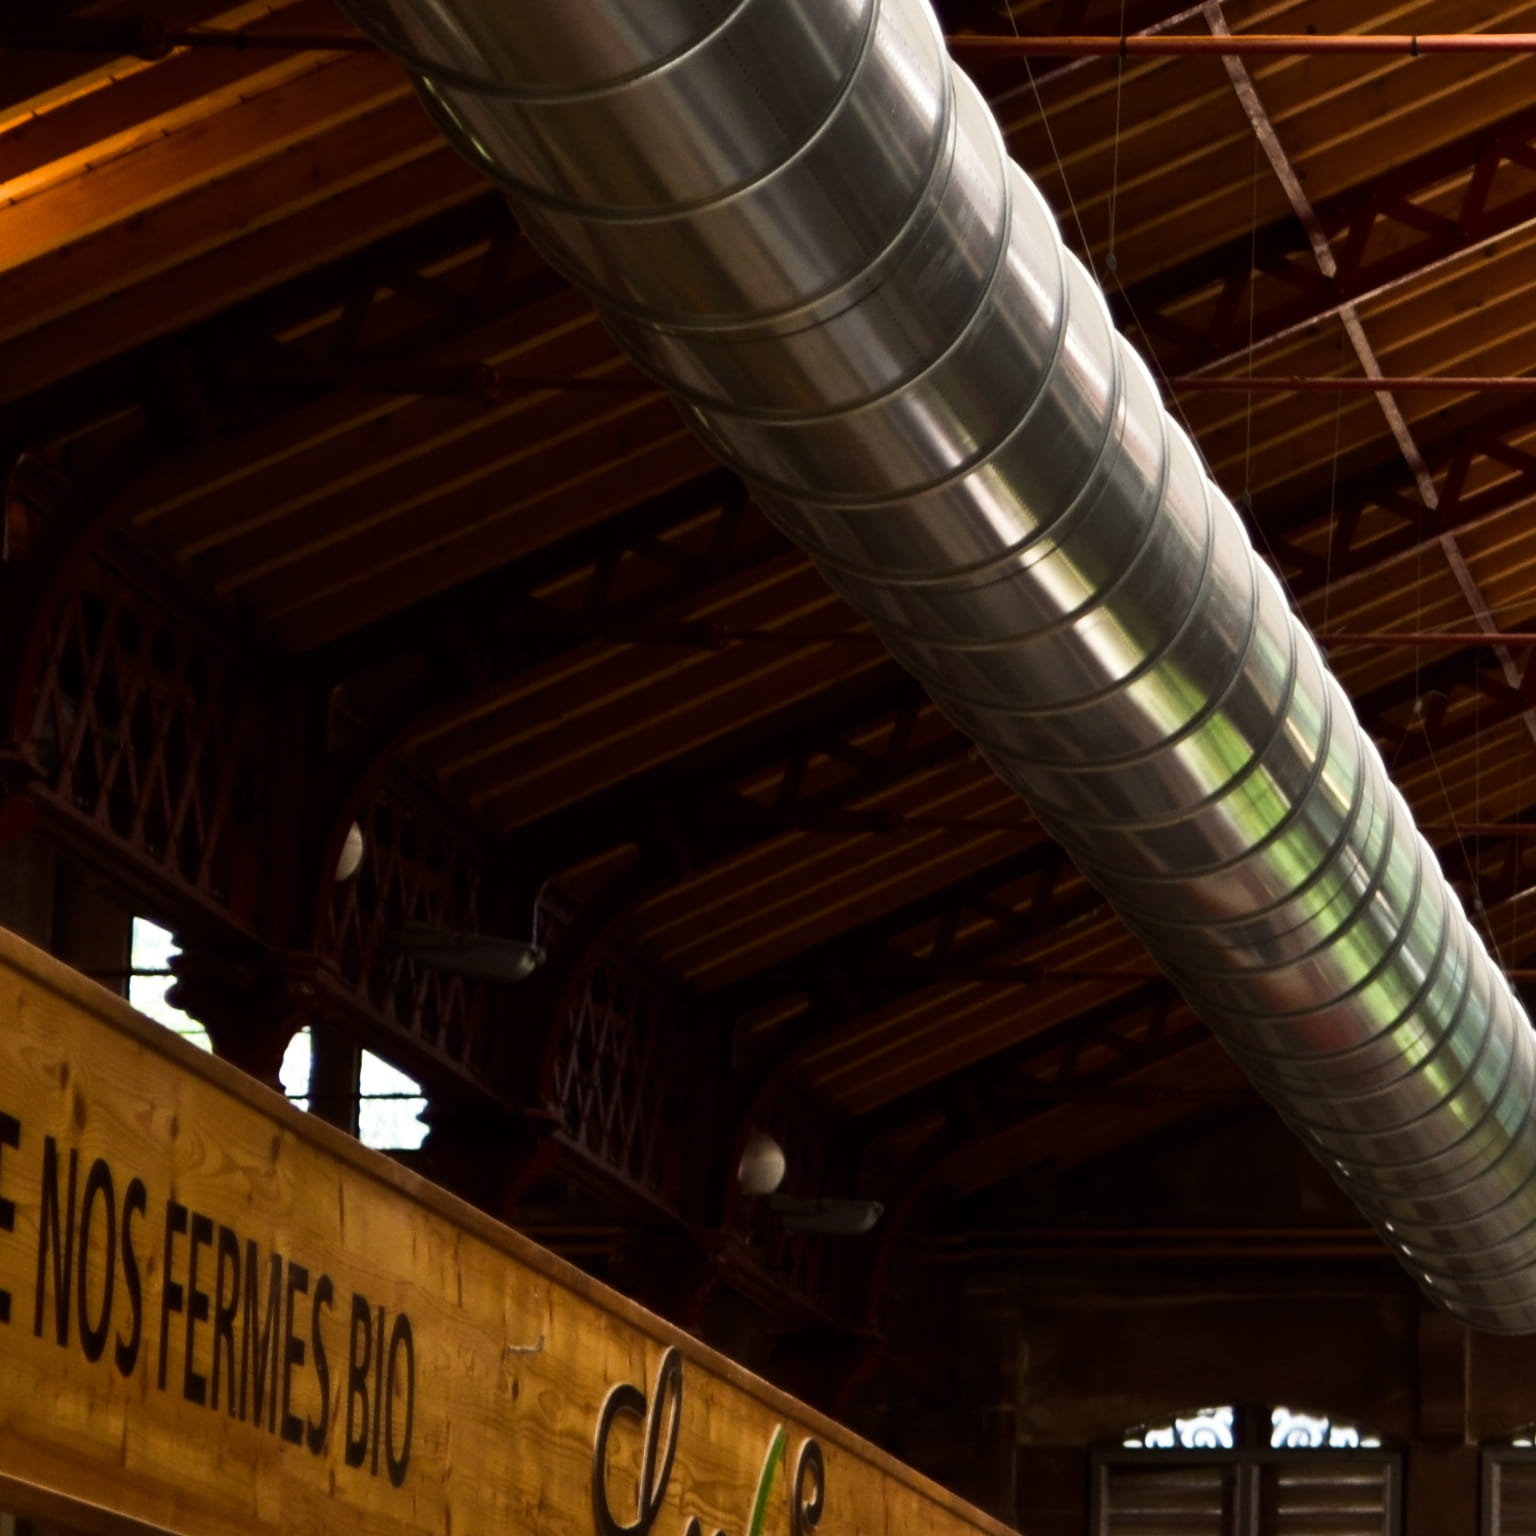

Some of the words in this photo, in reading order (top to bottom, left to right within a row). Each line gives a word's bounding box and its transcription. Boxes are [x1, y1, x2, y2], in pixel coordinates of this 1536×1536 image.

[34, 1135, 147, 1378] NOS
[157, 1200, 334, 1456] FERMES
[345, 1292, 415, 1488] BIO
